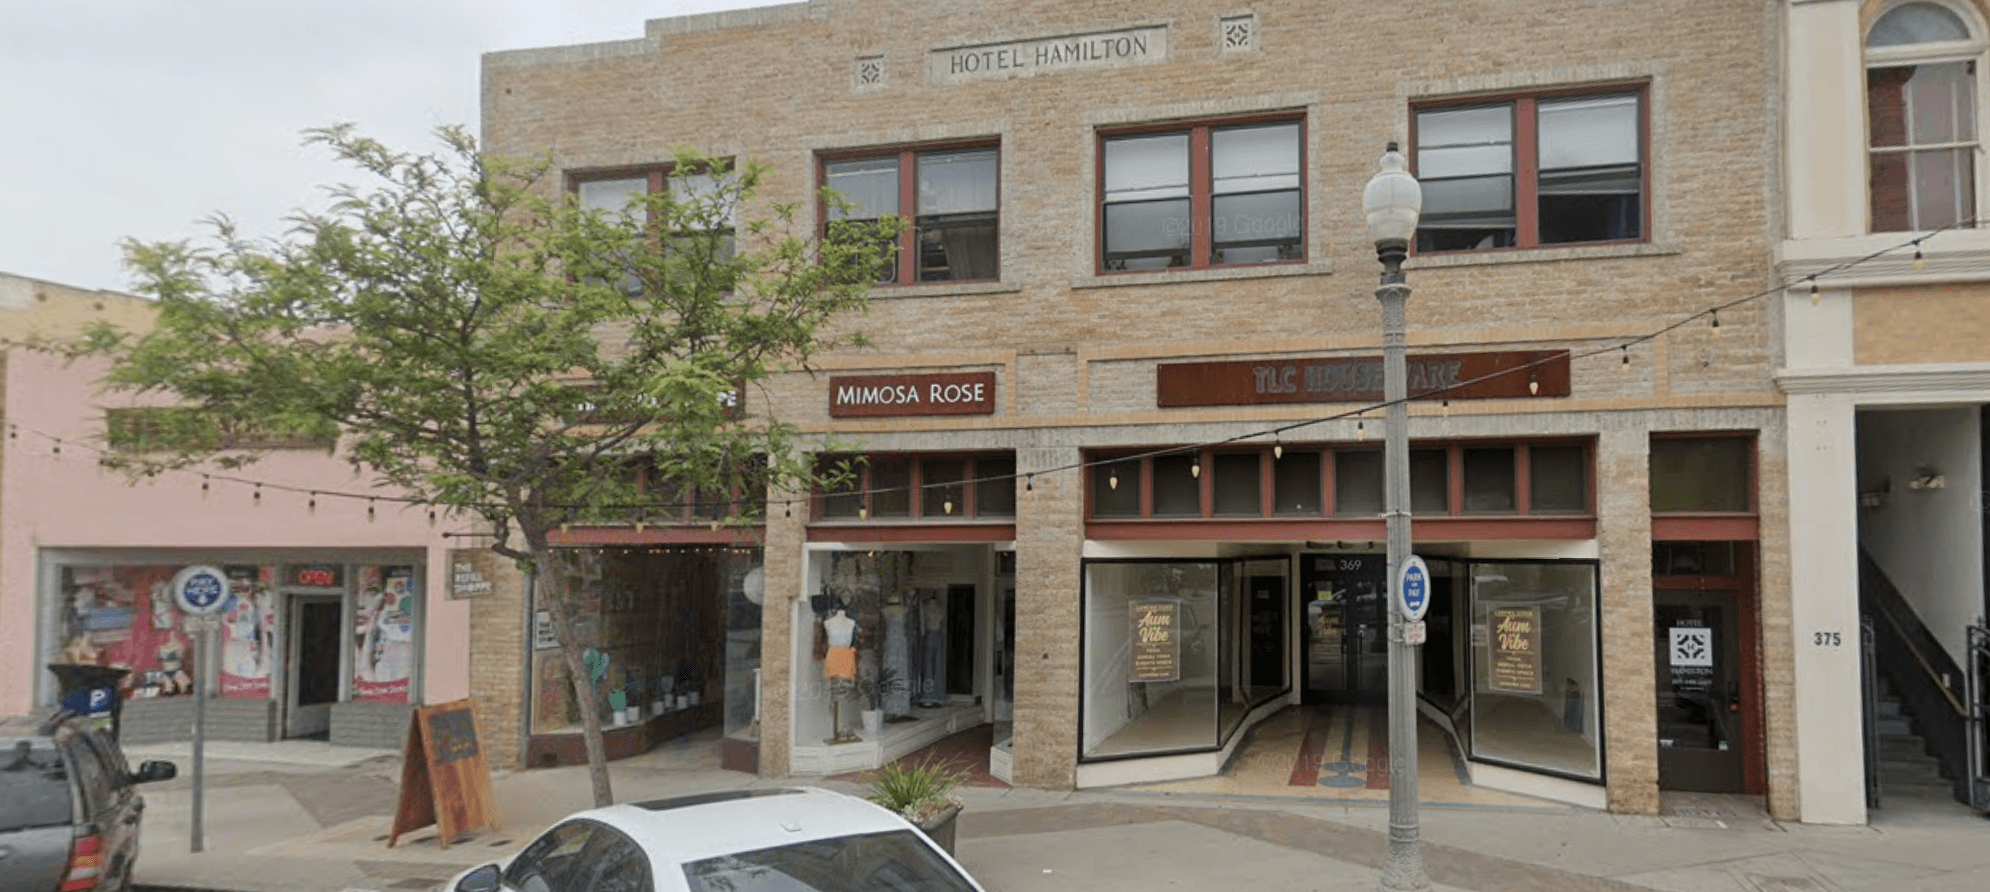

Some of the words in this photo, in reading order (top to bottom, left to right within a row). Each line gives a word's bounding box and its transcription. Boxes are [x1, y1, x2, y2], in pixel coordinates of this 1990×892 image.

[949, 50, 1025, 75] HOTEL
[1035, 35, 1149, 67] HAMILTON
[1253, 366, 1298, 394] TLC
[1304, 359, 1462, 393] HOUSEARE
[836, 385, 920, 405] MIMOSA
[930, 383, 985, 403] ROSE
[1340, 559, 1361, 571] 369
[299, 570, 334, 585] OPEN
[1138, 611, 1172, 628] Aum
[1497, 616, 1531, 634] Aum
[1139, 627, 1169, 644] Vibe
[1499, 632, 1530, 650] Vibe
[1814, 631, 1841, 646] 375
